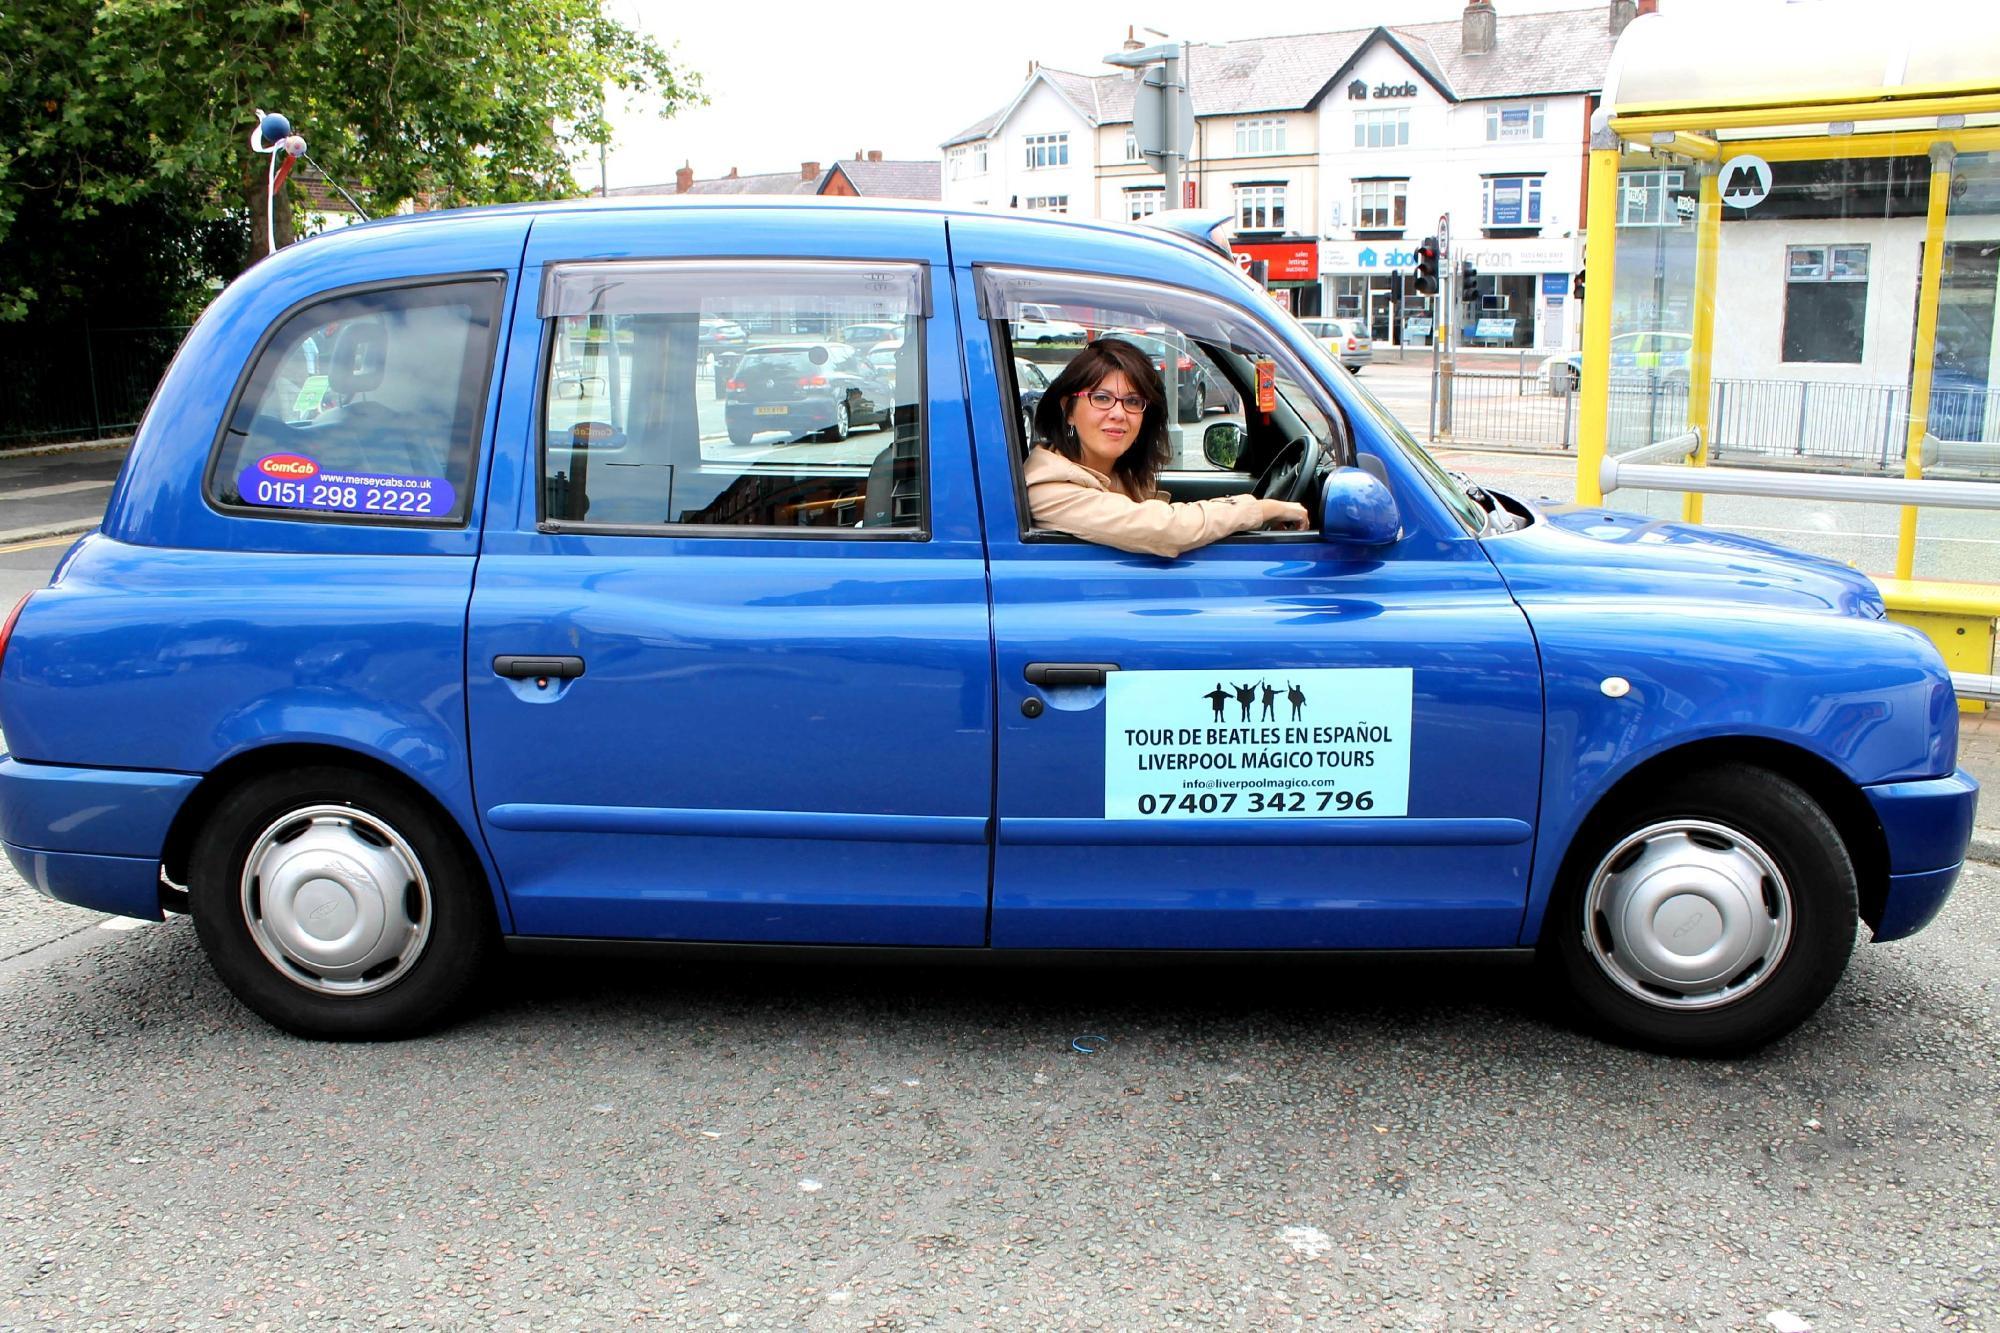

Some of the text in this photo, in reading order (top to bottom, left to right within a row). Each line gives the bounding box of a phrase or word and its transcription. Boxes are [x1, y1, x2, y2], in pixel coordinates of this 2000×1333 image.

[1373, 80, 1417, 98] abode
[1288, 259, 1309, 267] lettings
[1384, 248, 1419, 267] abo
[263, 460, 314, 475] ComCab
[320, 473, 432, 489] www.merseycabs.co.uk
[258, 480, 432, 513] 0151 298 2222
[1125, 721, 1392, 746] TOUR DE BEATLES EN ESPAÑOL
[1138, 747, 1375, 771] LIVERPOOL MÁGICO TOURS
[1182, 778, 1335, 791] info@liverpoolmagico.com
[1137, 791, 1375, 815] 07407 342 796
